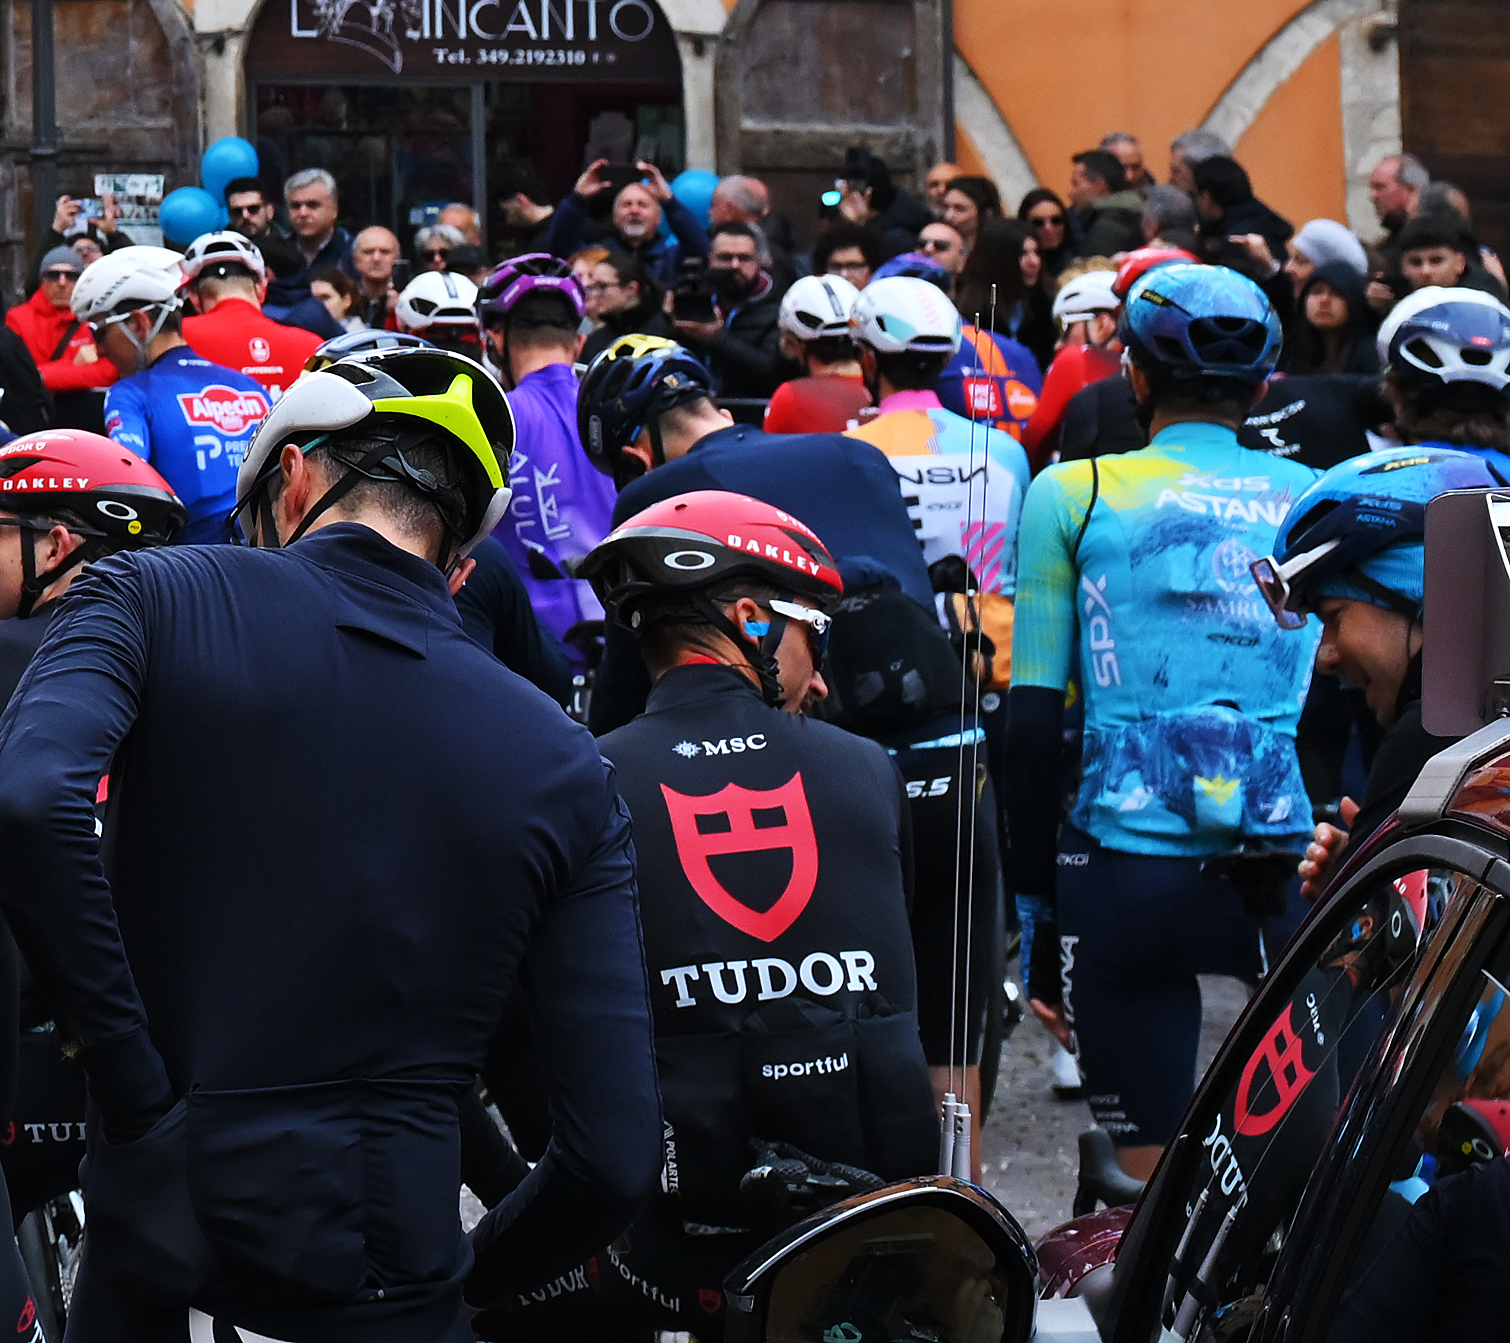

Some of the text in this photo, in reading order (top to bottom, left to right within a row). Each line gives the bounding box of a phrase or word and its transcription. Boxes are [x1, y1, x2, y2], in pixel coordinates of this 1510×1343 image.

[432, 47, 586, 65] Tel. 349.2192310
[192, 393, 263, 423] Alpecin
[3, 477, 90, 492] OAKLEY
[727, 534, 820, 577] OAKLEY
[703, 733, 767, 756] MSC
[660, 950, 878, 1008] TUDOR
[762, 1053, 849, 1080] sportful
